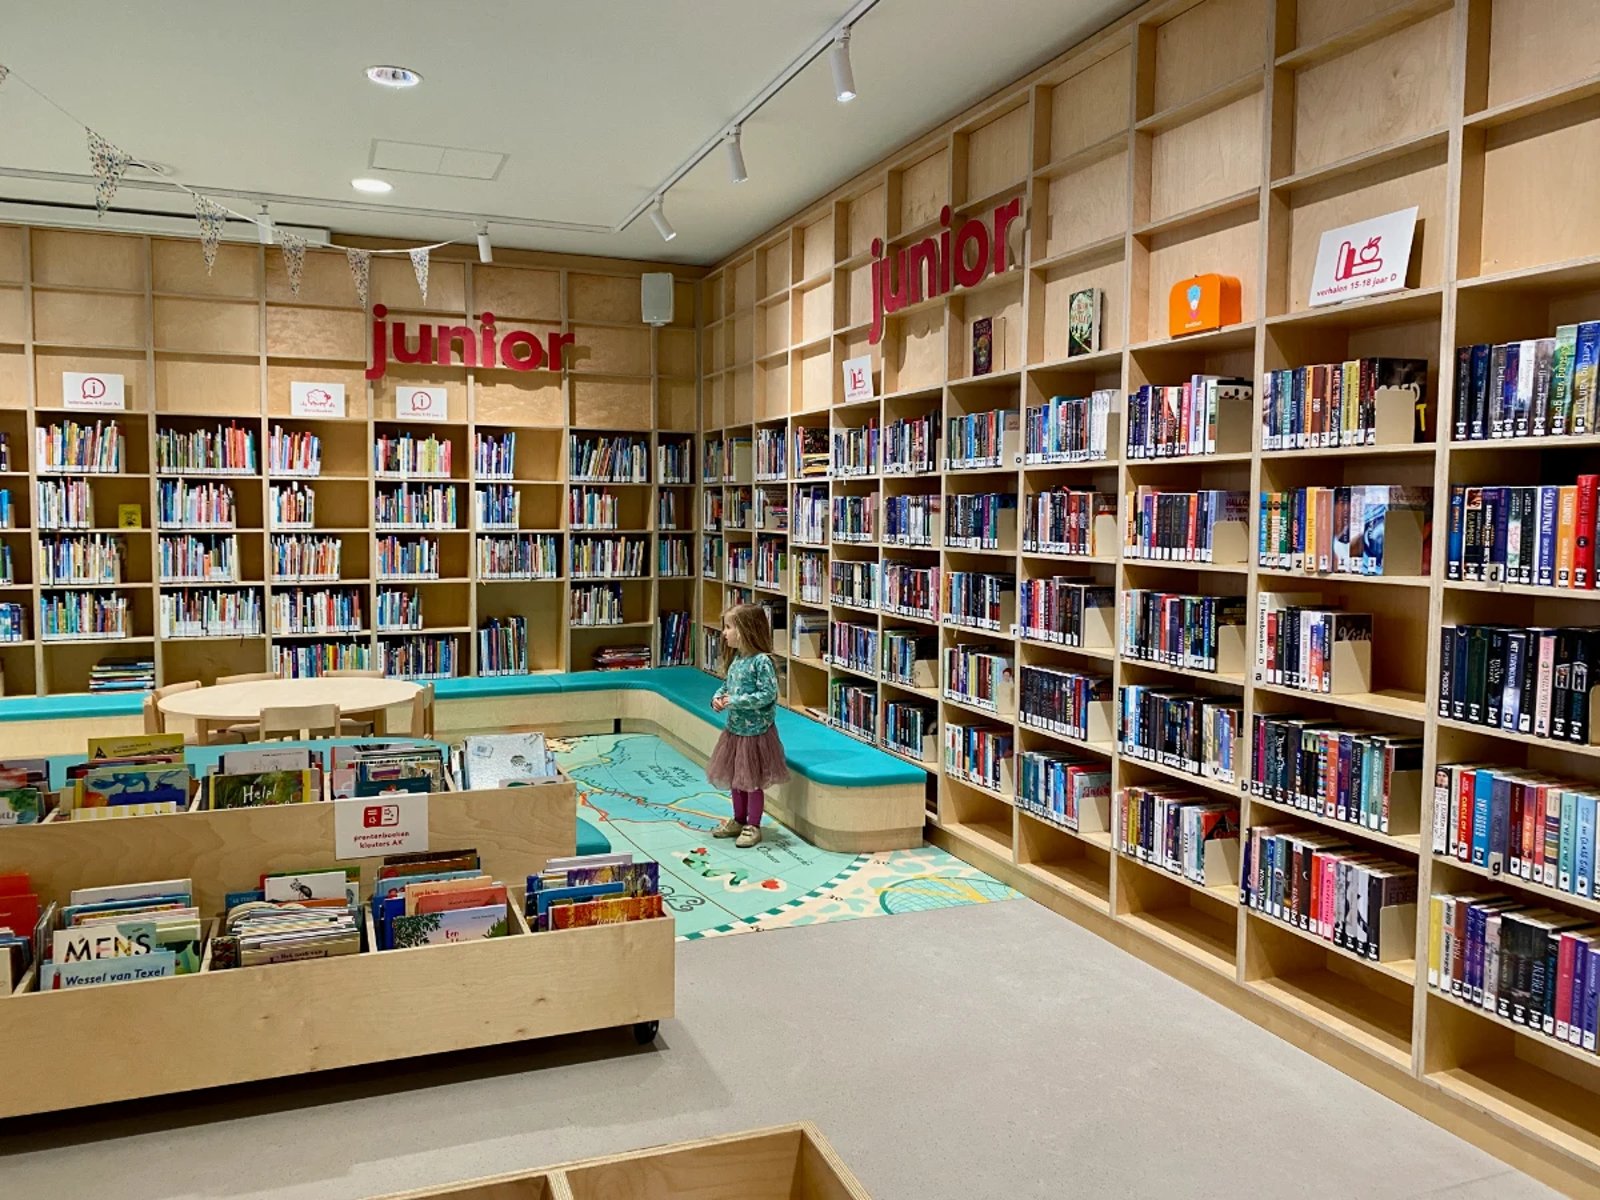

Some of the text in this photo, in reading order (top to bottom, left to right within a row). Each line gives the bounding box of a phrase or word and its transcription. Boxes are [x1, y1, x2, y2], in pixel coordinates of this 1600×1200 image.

[867, 197, 1020, 345] junior
[1350, 278, 1371, 290] 15-18
[1372, 276, 1388, 288] jaar
[1390, 273, 1397, 282] D
[365, 303, 575, 380] junior
[1489, 566, 1498, 581] d
[1255, 672, 1262, 681] a
[1441, 670, 1450, 696] PHOBOS
[243, 783, 277, 804] Help!
[1241, 779, 1249, 792] b
[1460, 796, 1468, 821] CIRCLE
[1492, 861, 1501, 876] g
[65, 933, 151, 963] MENS
[65, 966, 165, 986] Wessel van Texel
[1531, 964, 1544, 994] REBEL
